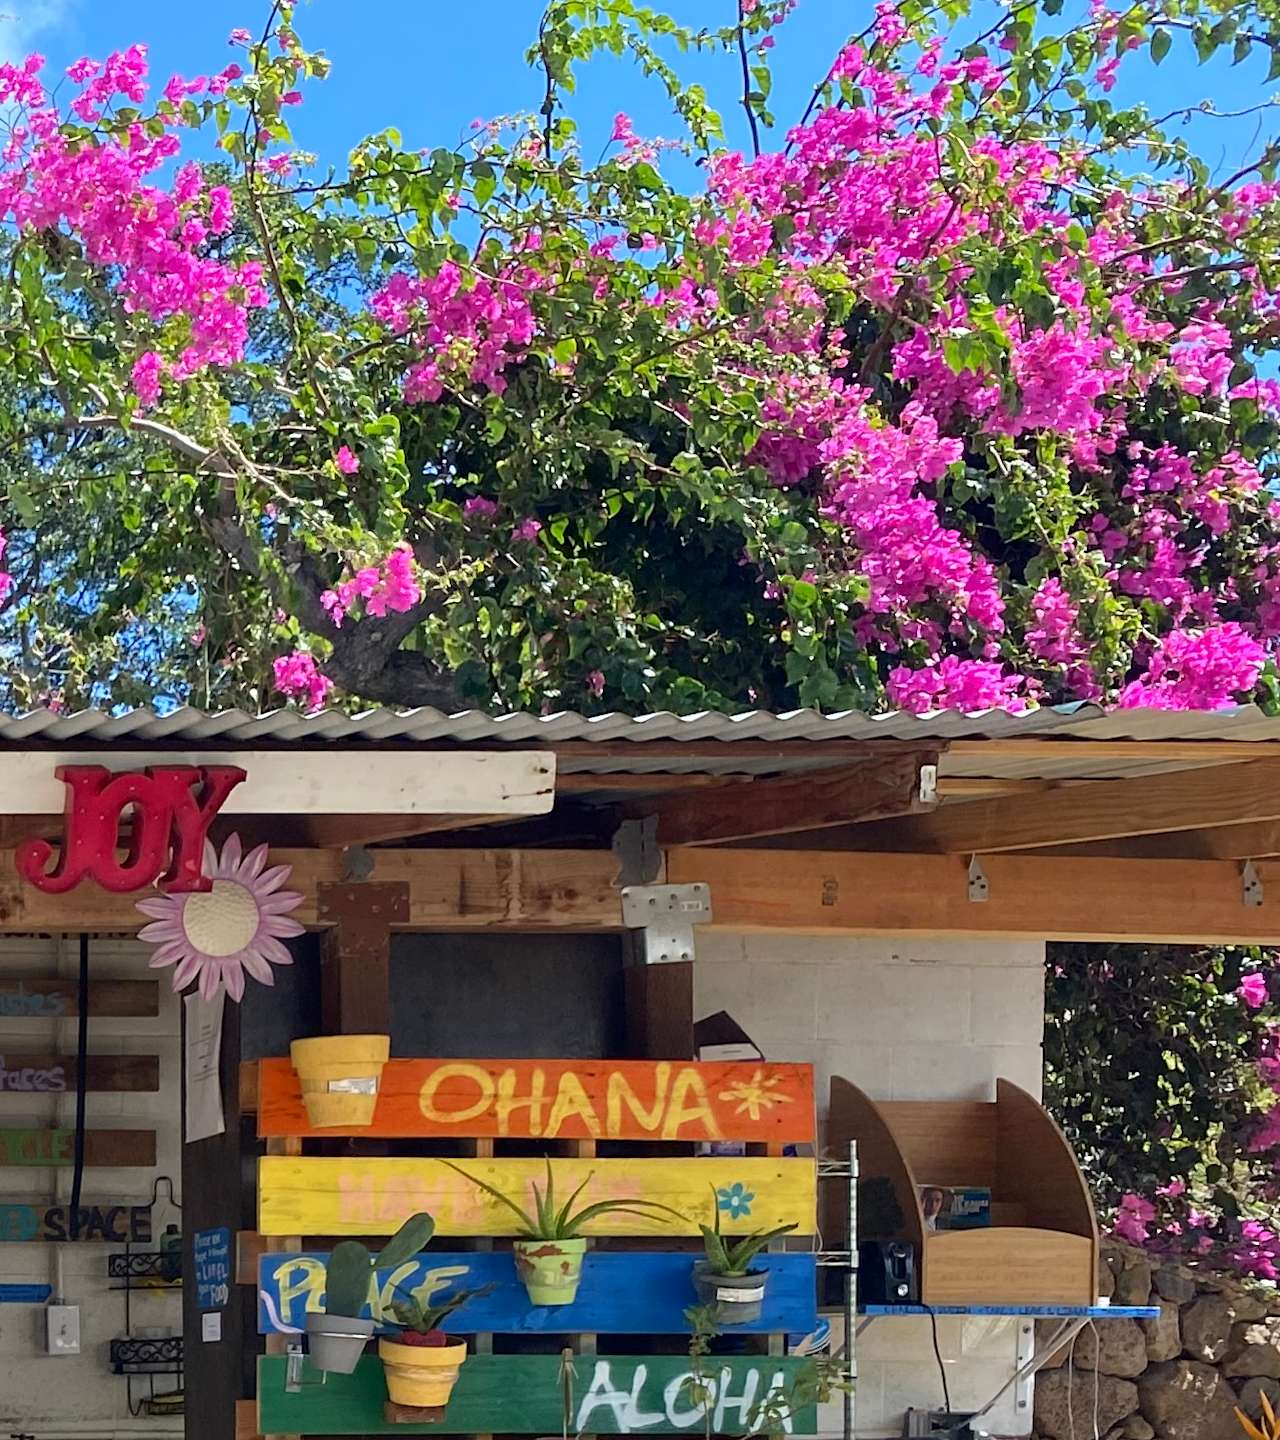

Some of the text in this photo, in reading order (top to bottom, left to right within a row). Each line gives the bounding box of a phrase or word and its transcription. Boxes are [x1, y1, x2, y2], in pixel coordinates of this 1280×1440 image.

[14, 764, 247, 893] JOY
[418, 1062, 723, 1139] OHANA
[44, 1207, 152, 1243] SPACE
[577, 1360, 794, 1433] ALOHA
